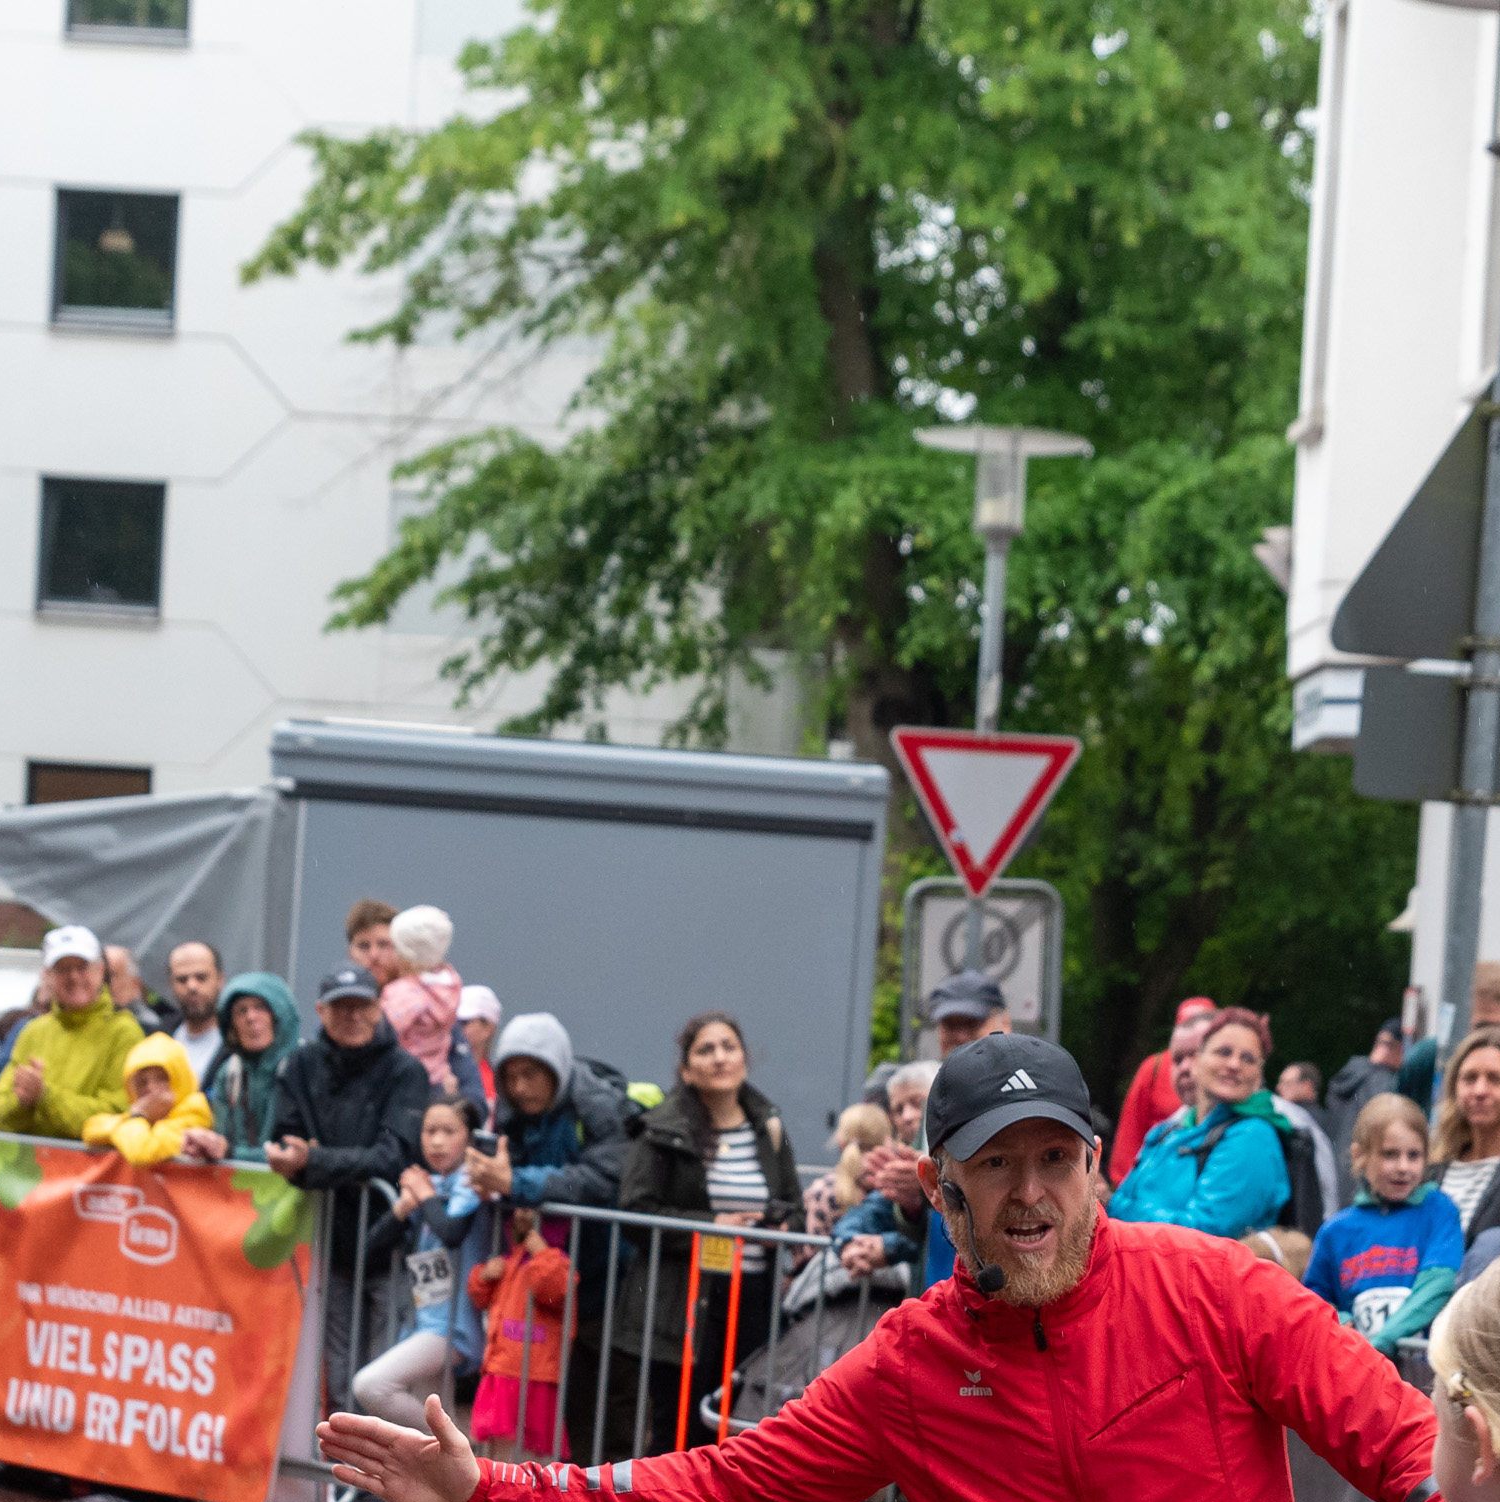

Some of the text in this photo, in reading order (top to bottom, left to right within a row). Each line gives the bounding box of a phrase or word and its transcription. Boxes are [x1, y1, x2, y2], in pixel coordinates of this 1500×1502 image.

[25, 1319, 217, 1397] VIEL SPASS
[959, 1385, 993, 1397] erima
[5, 1376, 227, 1465] UND ERFOLG!
